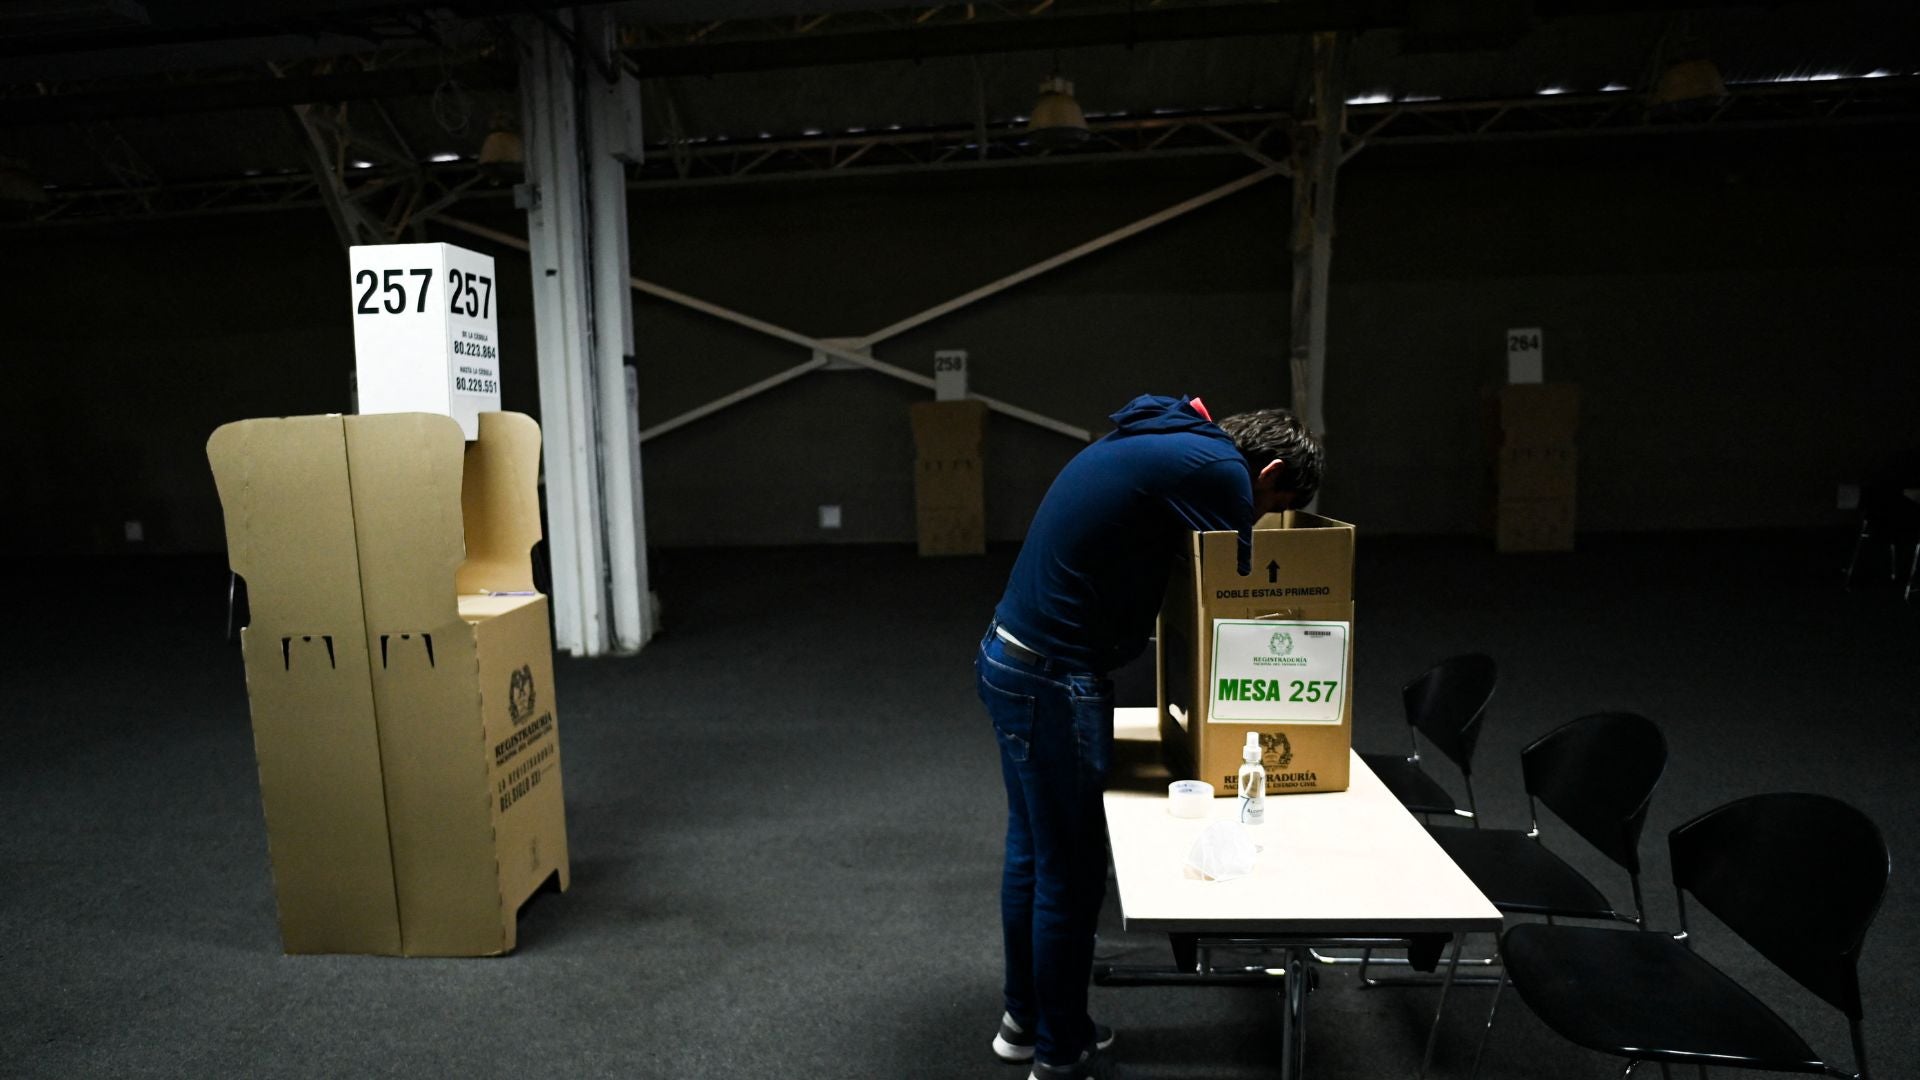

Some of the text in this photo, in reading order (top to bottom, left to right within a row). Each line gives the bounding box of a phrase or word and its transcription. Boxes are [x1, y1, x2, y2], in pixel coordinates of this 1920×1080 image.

[356, 269, 433, 315] 257
[449, 268, 492, 319] 257
[454, 340, 496, 359] 80.223.864
[1510, 334, 1538, 351] 264
[935, 356, 962, 371] 258
[1216, 586, 1330, 599] DOBLE ESTAS PRIMERO
[1218, 679, 1338, 702] MESA 257
